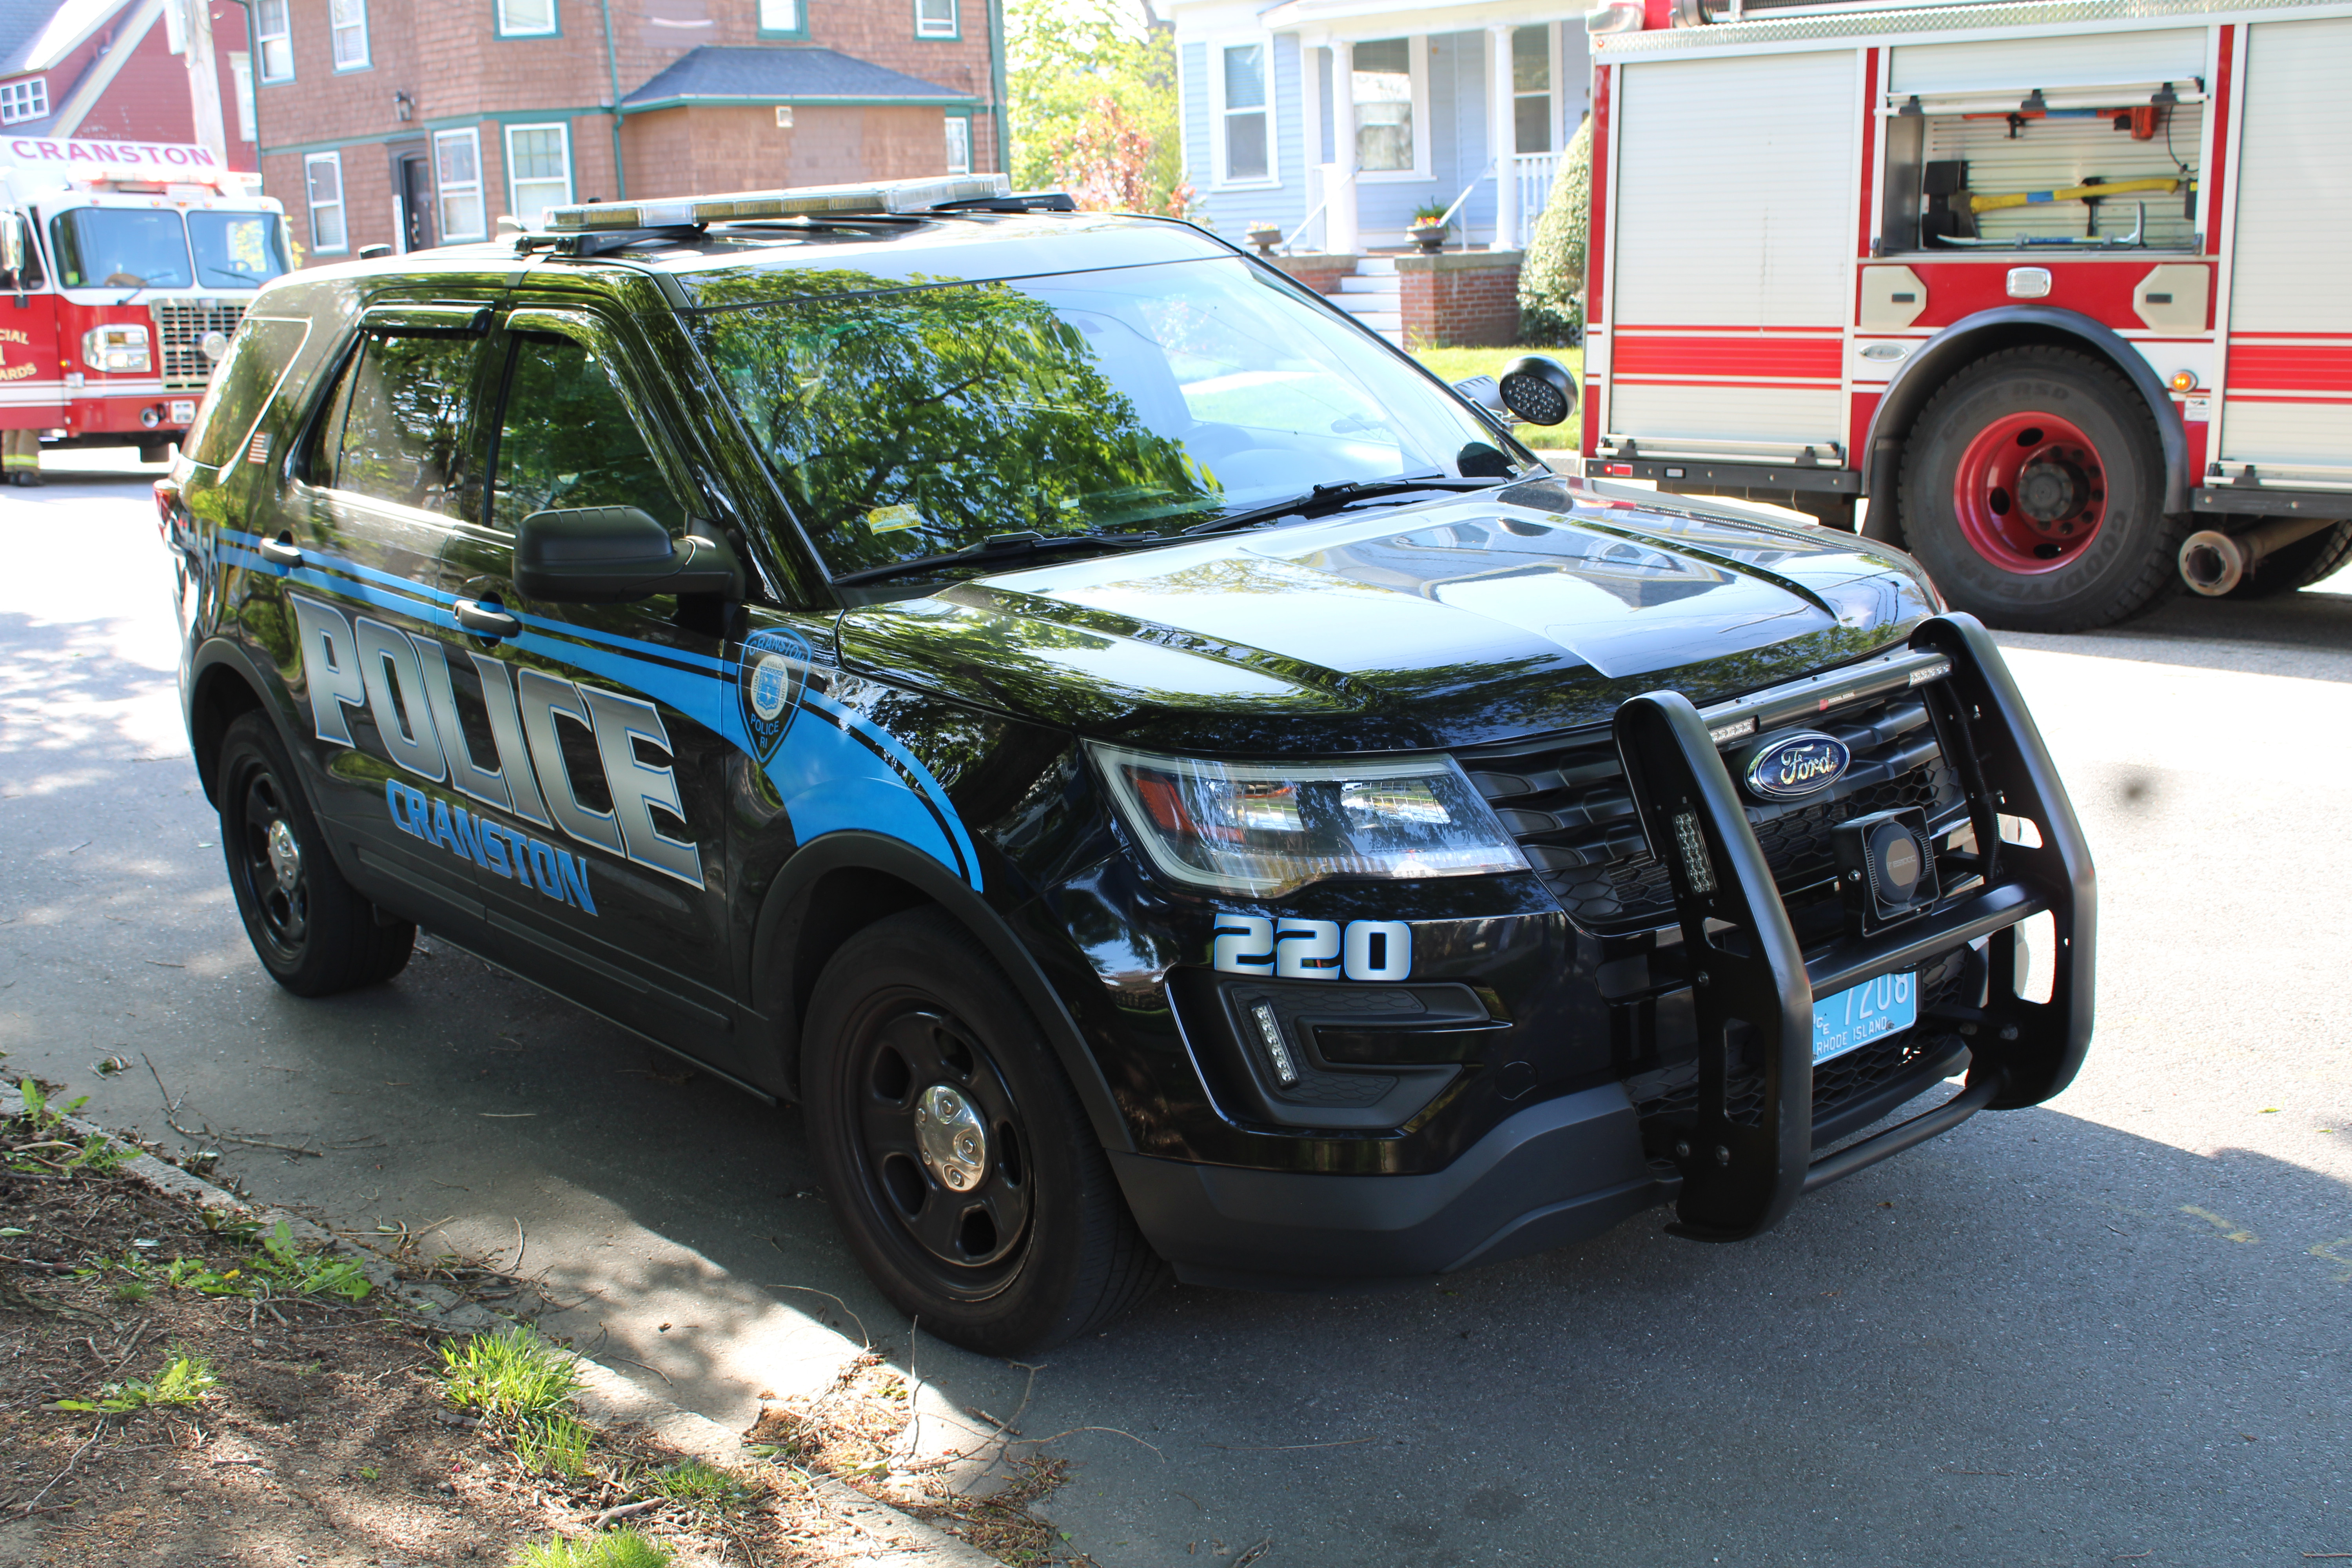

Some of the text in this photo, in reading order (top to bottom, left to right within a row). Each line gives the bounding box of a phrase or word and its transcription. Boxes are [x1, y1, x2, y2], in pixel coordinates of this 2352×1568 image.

[12, 140, 215, 167] CRANSTON
[748, 635, 805, 668] CRANSTON
[767, 660, 782, 669] VIGILO
[288, 591, 705, 891] POLICE
[750, 713, 779, 735] POLICE
[760, 736, 768, 749] RI
[1780, 743, 1834, 785] Ford
[385, 778, 598, 916] CRANSTON
[1214, 913, 1411, 980] 220
[1816, 1016, 1887, 1056] RHODE ISLAND
